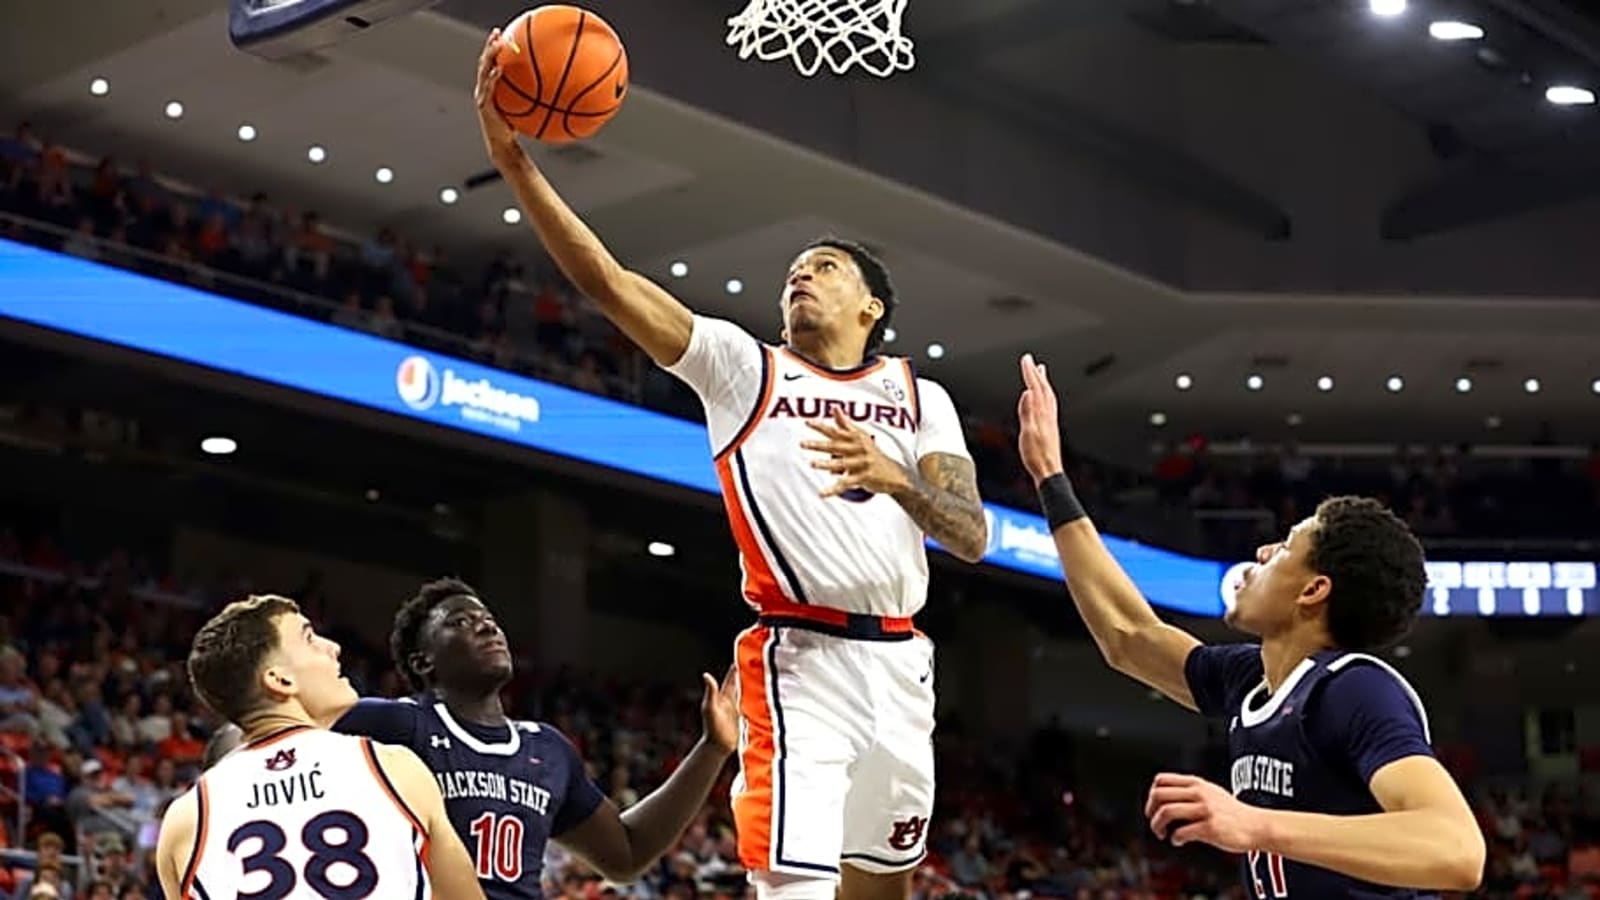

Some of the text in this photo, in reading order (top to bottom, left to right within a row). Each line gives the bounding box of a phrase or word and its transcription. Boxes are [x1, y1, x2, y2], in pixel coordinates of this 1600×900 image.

[768, 396, 917, 434] AUBURN
[246, 762, 325, 809] JOVIĆ
[436, 771, 551, 816] JACKSON STATE
[1253, 755, 1294, 797] STATE
[226, 809, 379, 900] 38
[470, 811, 524, 882] 10
